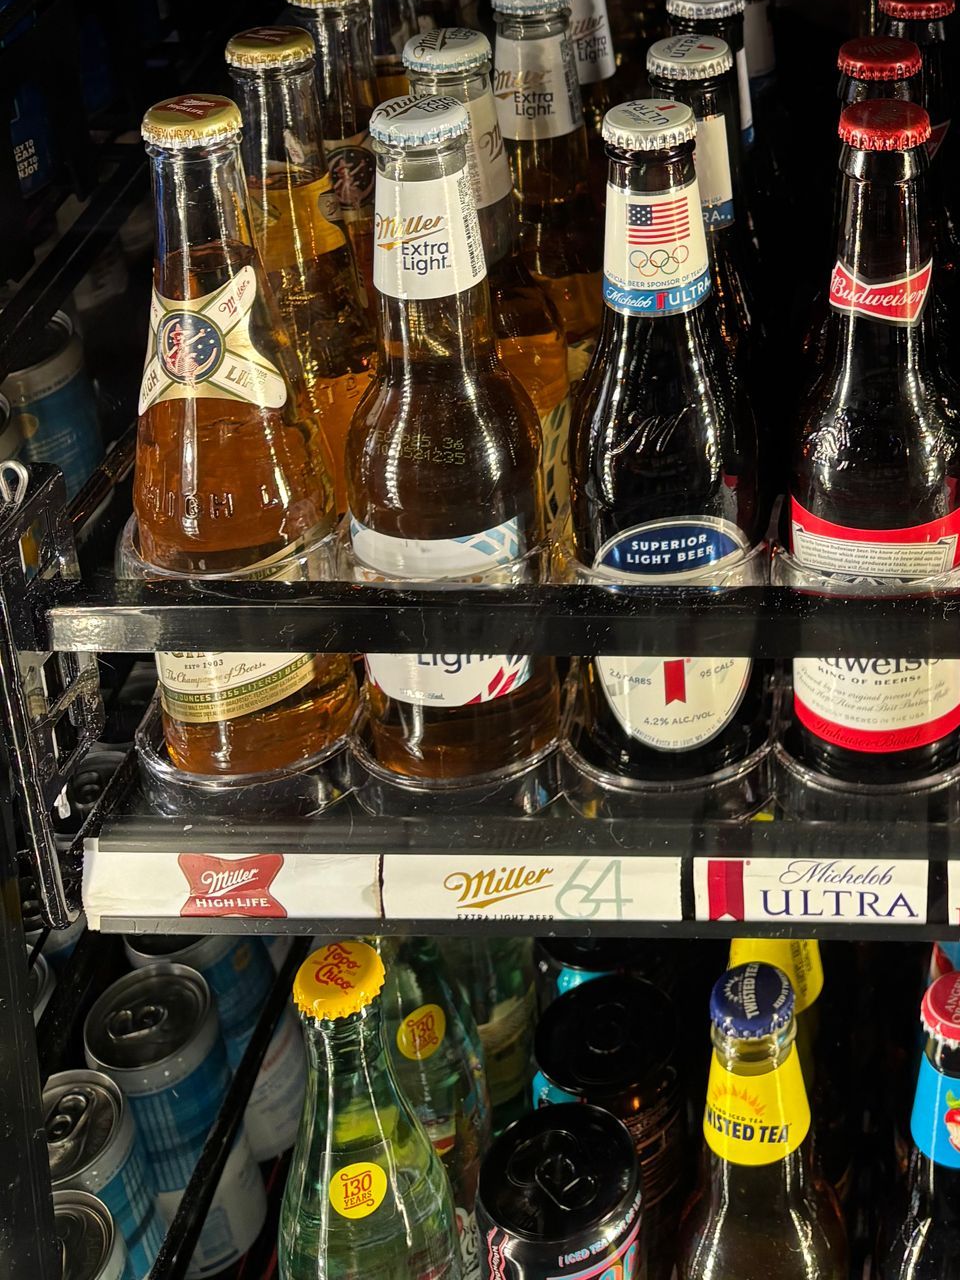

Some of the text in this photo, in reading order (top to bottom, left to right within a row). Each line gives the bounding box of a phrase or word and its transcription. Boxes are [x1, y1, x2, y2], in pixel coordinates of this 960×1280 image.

[576, 35, 607, 49] Extra
[578, 46, 607, 65] Light
[513, 91, 553, 104] Extra
[515, 102, 552, 120] Light
[375, 212, 445, 240] Miller
[401, 241, 449, 256] Extra
[403, 254, 448, 276] Light
[647, 275, 690, 288] SPONSOR OF
[669, 278, 711, 306] ULTRA
[831, 272, 926, 307] Budweiser
[605, 286, 653, 309] Michelob
[631, 533, 707, 551] SUPERIOR
[626, 545, 714, 565] LIGHT BEER
[699, 658, 735, 679] 95 CALS
[817, 665, 867, 685] KING OF
[643, 716, 670, 727] 4.2%
[201, 868, 259, 895] Miller
[778, 859, 894, 886] Michelob
[443, 858, 633, 920] Miller 64
[196, 898, 270, 908] HIGH LIFE
[760, 889, 919, 918] ULTRA
[326, 941, 361, 971] Topo
[314, 963, 355, 991] Chico
[742, 976, 760, 1020] TWISTED
[759, 1123, 790, 1144] TEA
[342, 1172, 373, 1199] 130
[343, 1190, 373, 1208] YEARS
